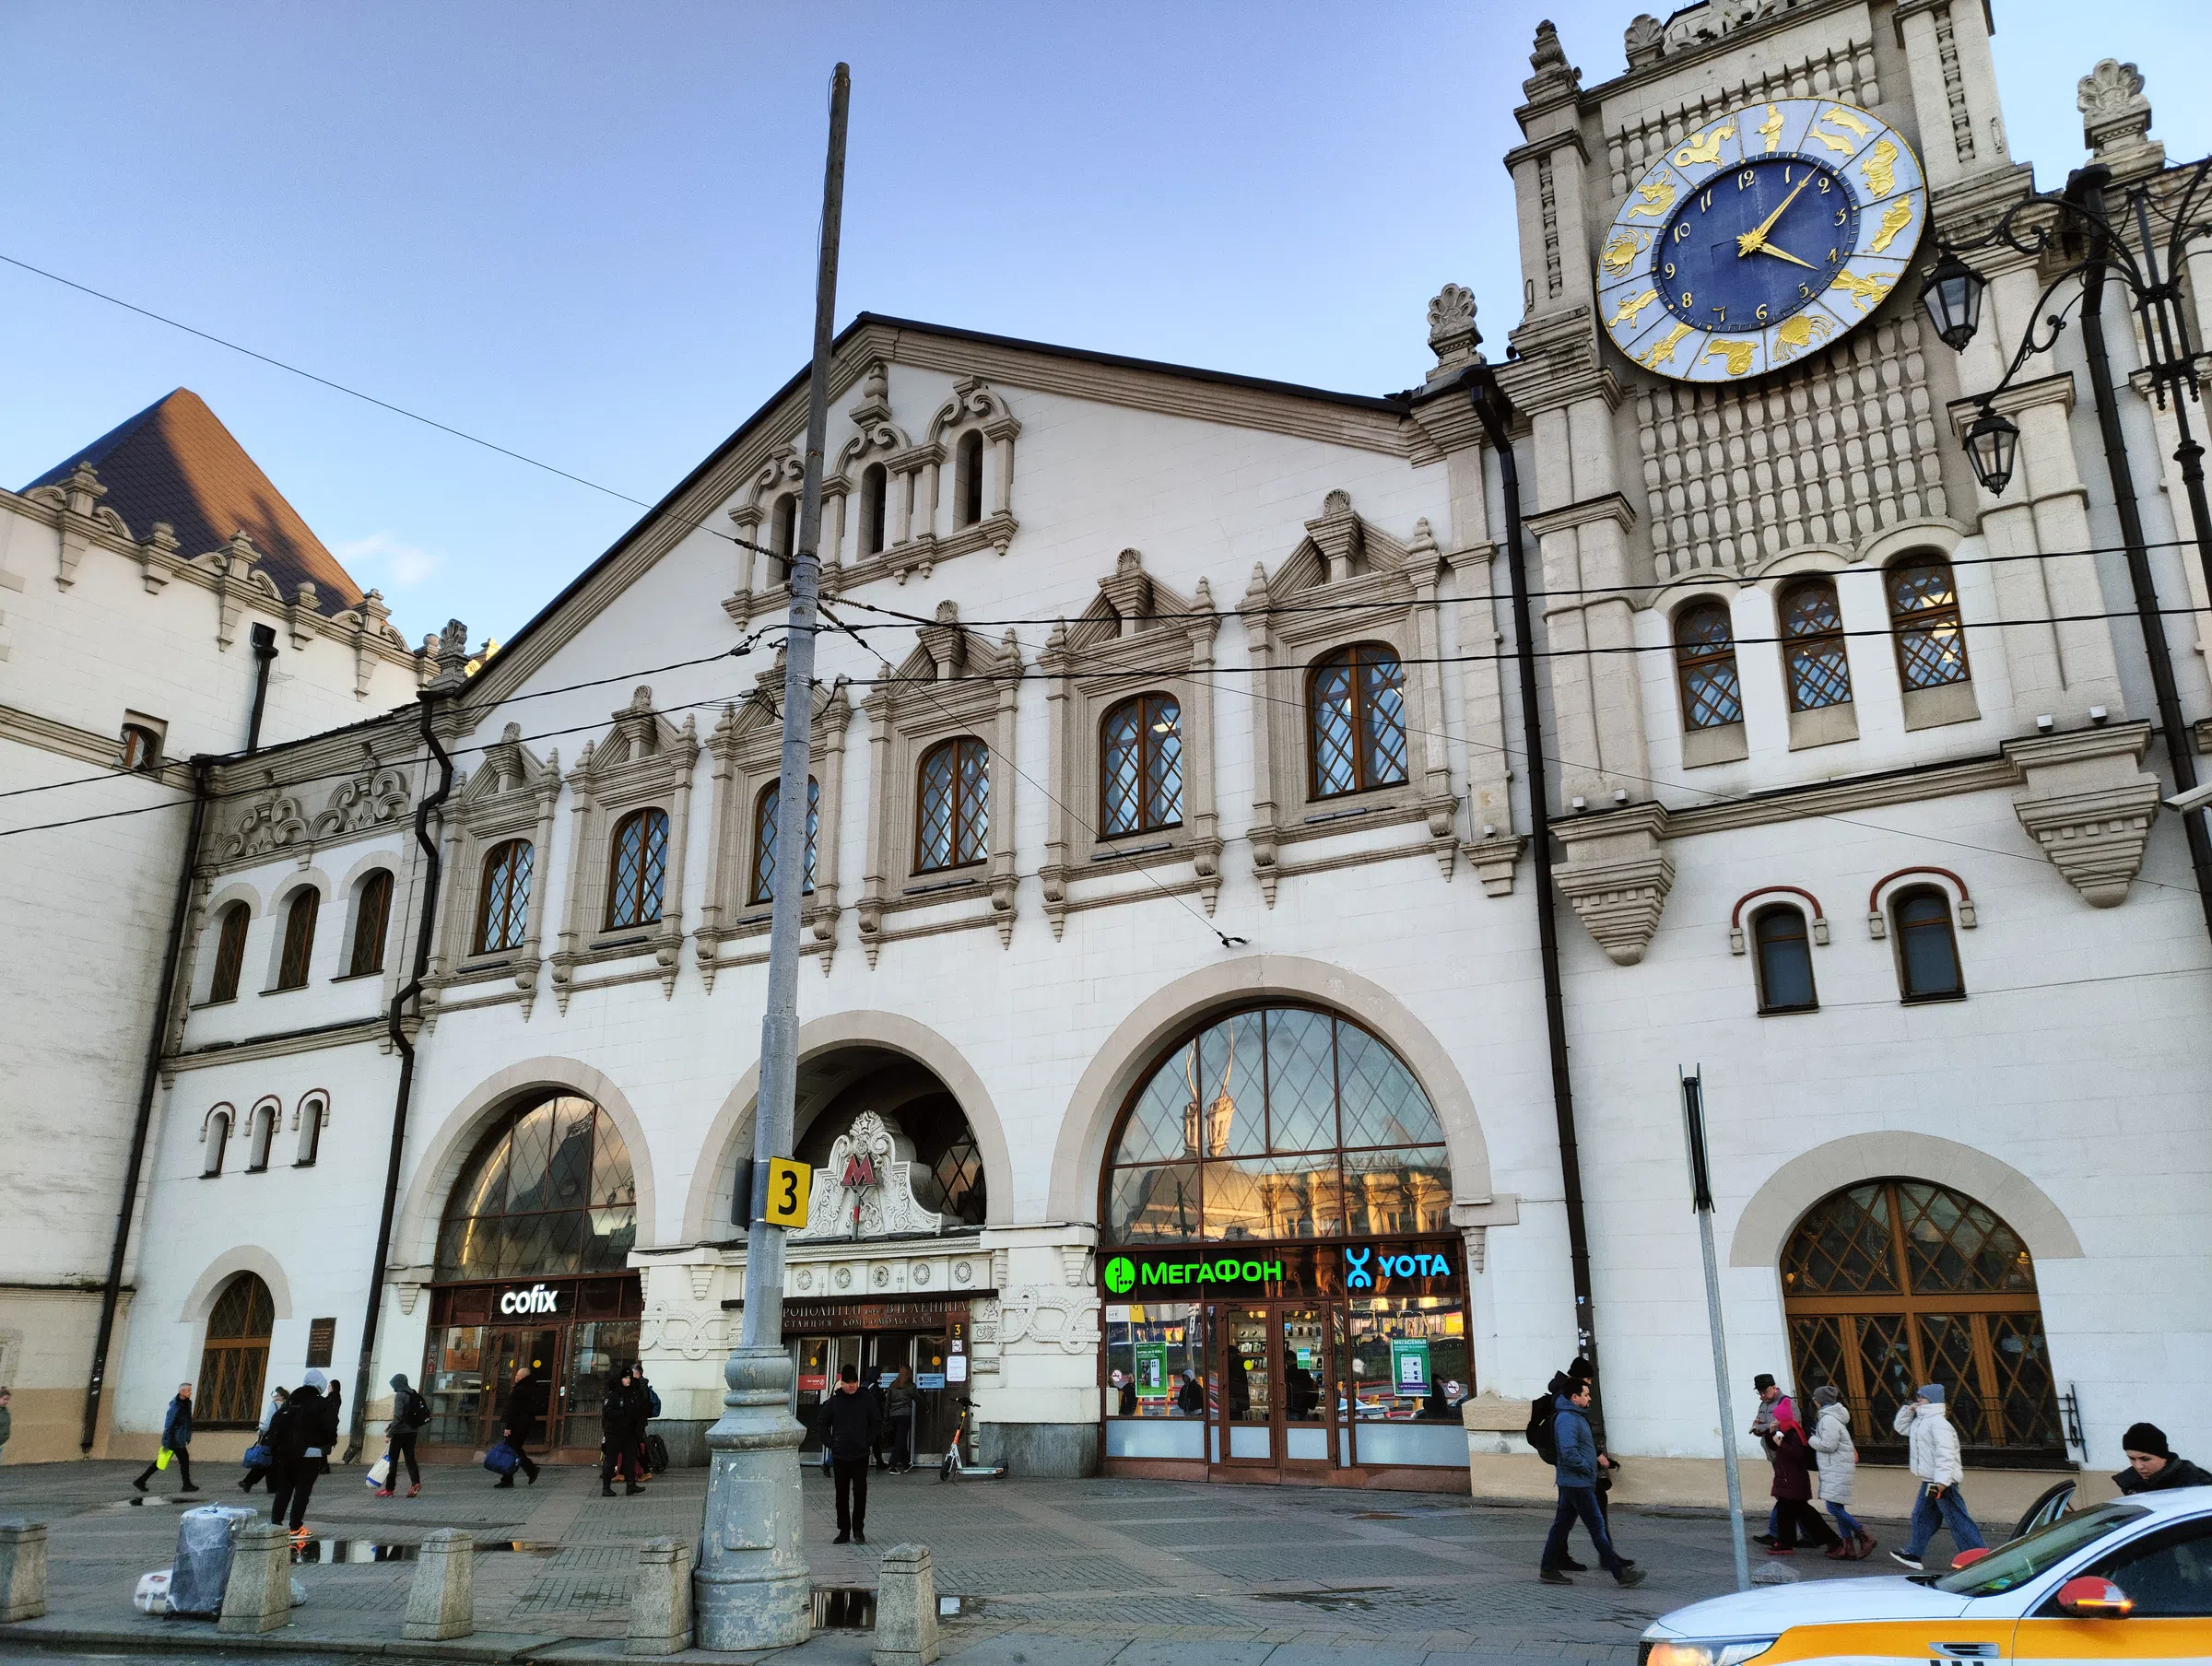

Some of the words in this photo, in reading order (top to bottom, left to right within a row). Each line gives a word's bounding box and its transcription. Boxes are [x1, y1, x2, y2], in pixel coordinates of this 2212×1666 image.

[1737, 170, 1755, 192] 12
[1784, 165, 1792, 184] 1
[1818, 177, 1831, 194] 2
[1700, 189, 1713, 213] 11
[1834, 208, 1847, 227] 3
[1674, 222, 1692, 243] 10
[1826, 248, 1839, 264] 4
[1665, 264, 1677, 279] 9
[1798, 281, 1810, 299] 5
[1681, 292, 1694, 309] 8
[1712, 305, 1726, 323] 7
[1755, 303, 1768, 319] 6
[841, 1153, 877, 1186] М
[778, 1169, 798, 1216] 3
[1378, 1253, 1452, 1278] YOTA
[500, 1283, 559, 1315] cofix
[782, 1304, 862, 1318] РОПОЛИТЕН
[911, 1300, 968, 1314] ЛЕНИНА
[784, 1319, 832, 1328] СТАНЦИЯ
[842, 1316, 933, 1327] КОМСОМОЛЬСКАЯ
[954, 1324, 961, 1335] 3
